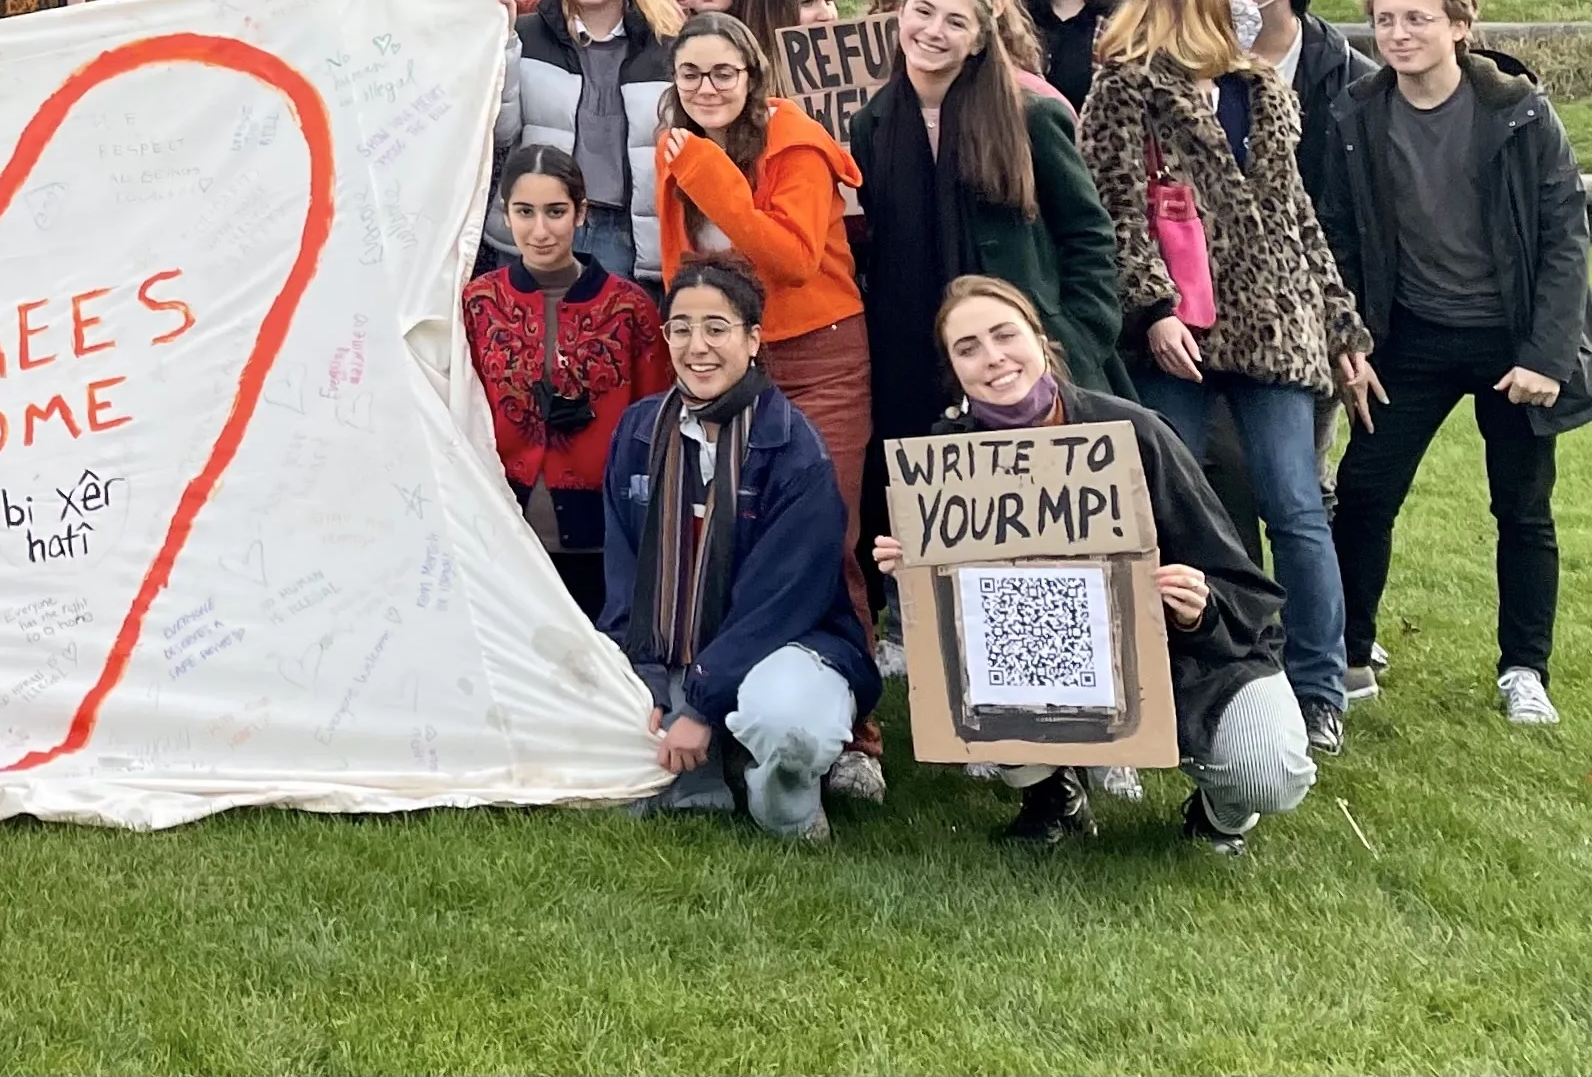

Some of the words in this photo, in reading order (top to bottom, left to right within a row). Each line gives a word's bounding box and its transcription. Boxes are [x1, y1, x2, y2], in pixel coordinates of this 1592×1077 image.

[896, 439, 1034, 486] WRITE
[1050, 434, 1115, 476] TO
[1, 488, 33, 528] bi
[918, 489, 1031, 557] YOUR
[27, 521, 96, 563] hatî
